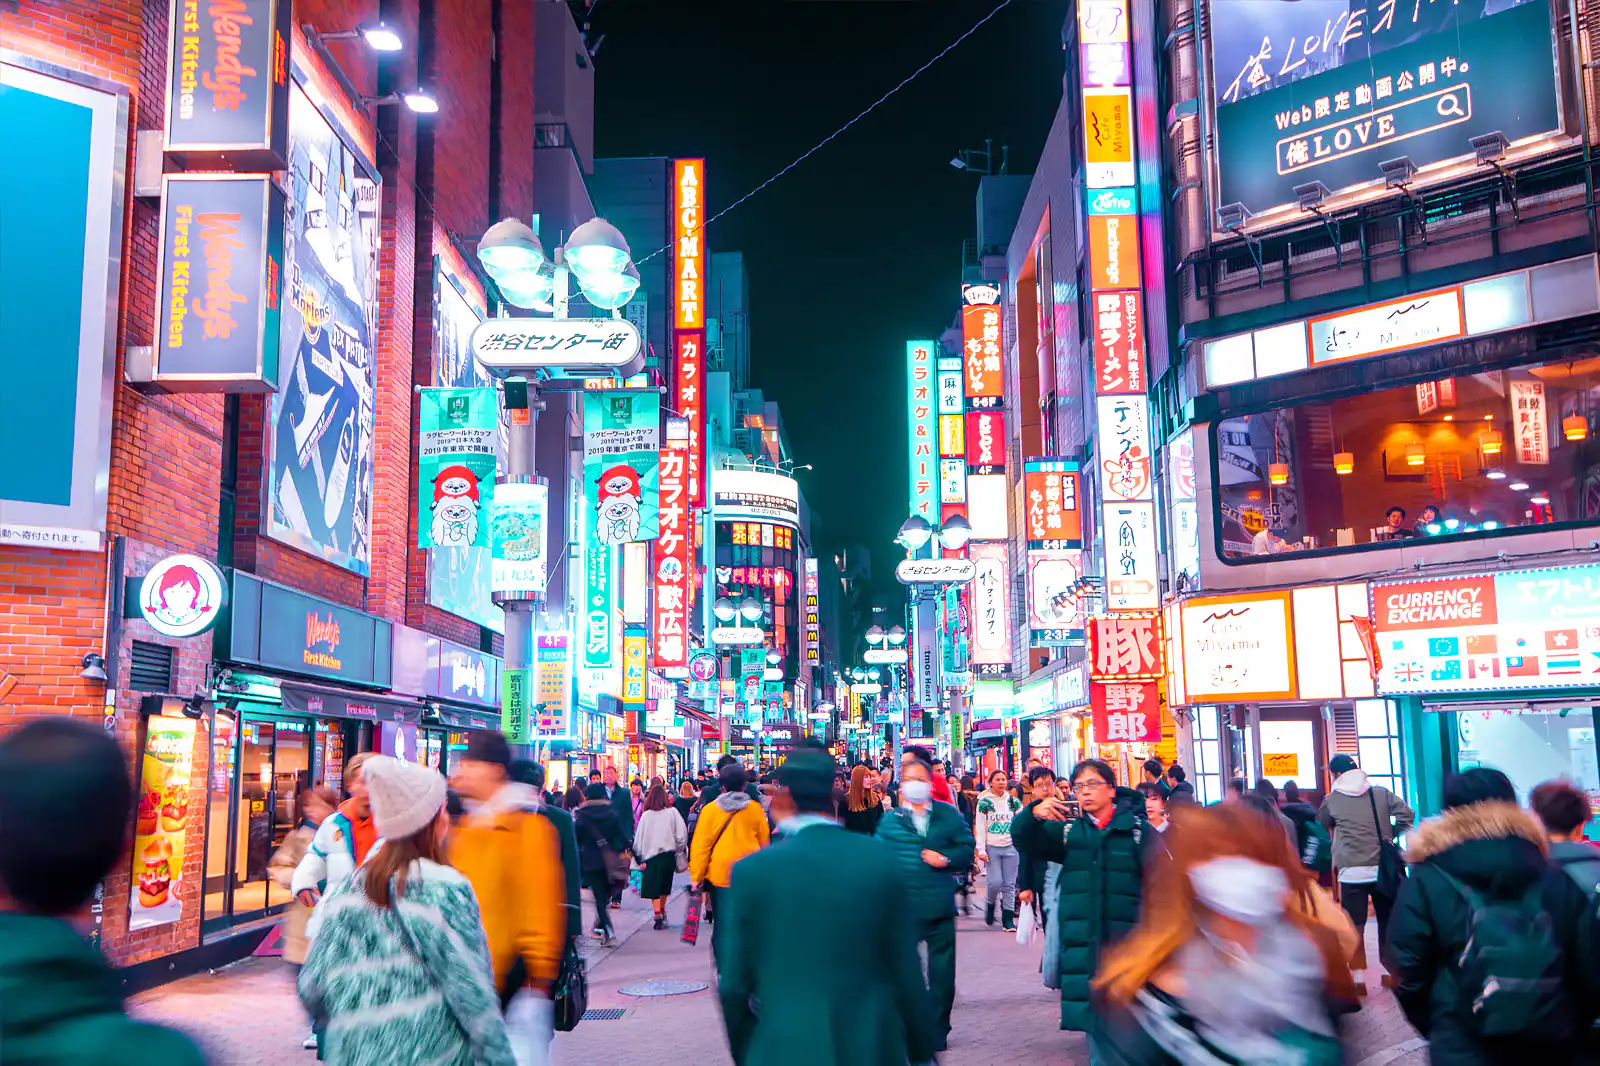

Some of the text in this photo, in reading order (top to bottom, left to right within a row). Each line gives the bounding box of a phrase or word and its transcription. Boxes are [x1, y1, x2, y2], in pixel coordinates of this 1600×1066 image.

[179, 36, 199, 120] Kitchen
[1275, 56, 1469, 130] Web限定動画公開中。
[1100, 116, 1110, 141] Cafe
[1113, 104, 1122, 153] Miyama
[1098, 196, 1131, 211] AirTrip
[1106, 218, 1120, 285] Exchange
[168, 205, 193, 348] First Kitchen
[193, 212, 248, 340] Wendy's
[479, 332, 630, 351] 渋谷センター街
[944, 377, 957, 407] 麻雀
[426, 430, 492, 440] ラグビーワールドカップ
[589, 428, 654, 439] ラグビーワールドカップ
[659, 451, 684, 556] カラオケ
[0, 528, 84, 544] 動へ寄付されます。
[1386, 586, 1482, 609] CURRENCY
[1387, 602, 1483, 625] EXCHANGE
[305, 611, 340, 653] Wendy's
[544, 636, 561, 647] 4F
[303, 649, 341, 671] First Kitchen
[1096, 619, 1156, 674] 豚
[626, 665, 643, 697] 松屋
[923, 677, 931, 703] Heart
[1106, 684, 1148, 741] 野郎
[1265, 767, 1297, 775] Miyama
